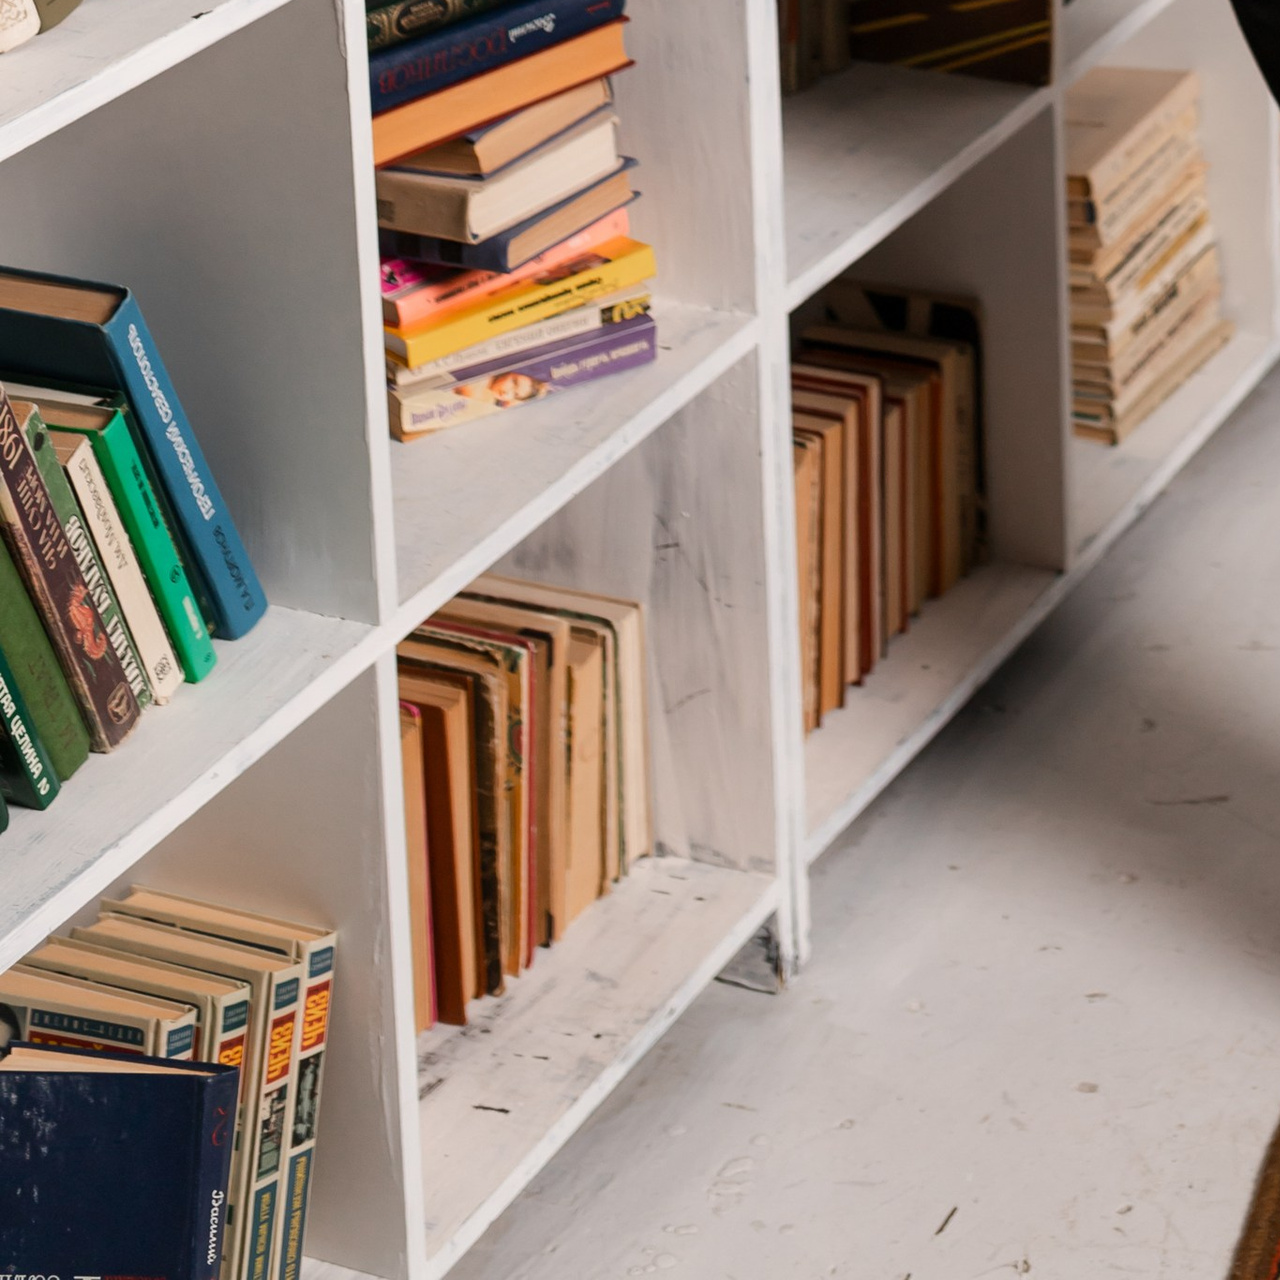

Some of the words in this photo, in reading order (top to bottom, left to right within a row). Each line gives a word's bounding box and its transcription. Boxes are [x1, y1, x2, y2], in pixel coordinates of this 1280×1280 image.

[128, 324, 172, 424] СЕВАСТОПОЛЬ
[166, 419, 216, 521] ГЕРОИЧЕСКИЙ
[65, 515, 112, 620] БУЛГАКОВ
[11, 714, 43, 779] ЦЕЛИНА
[207, 1189, 225, 1266] Василий
